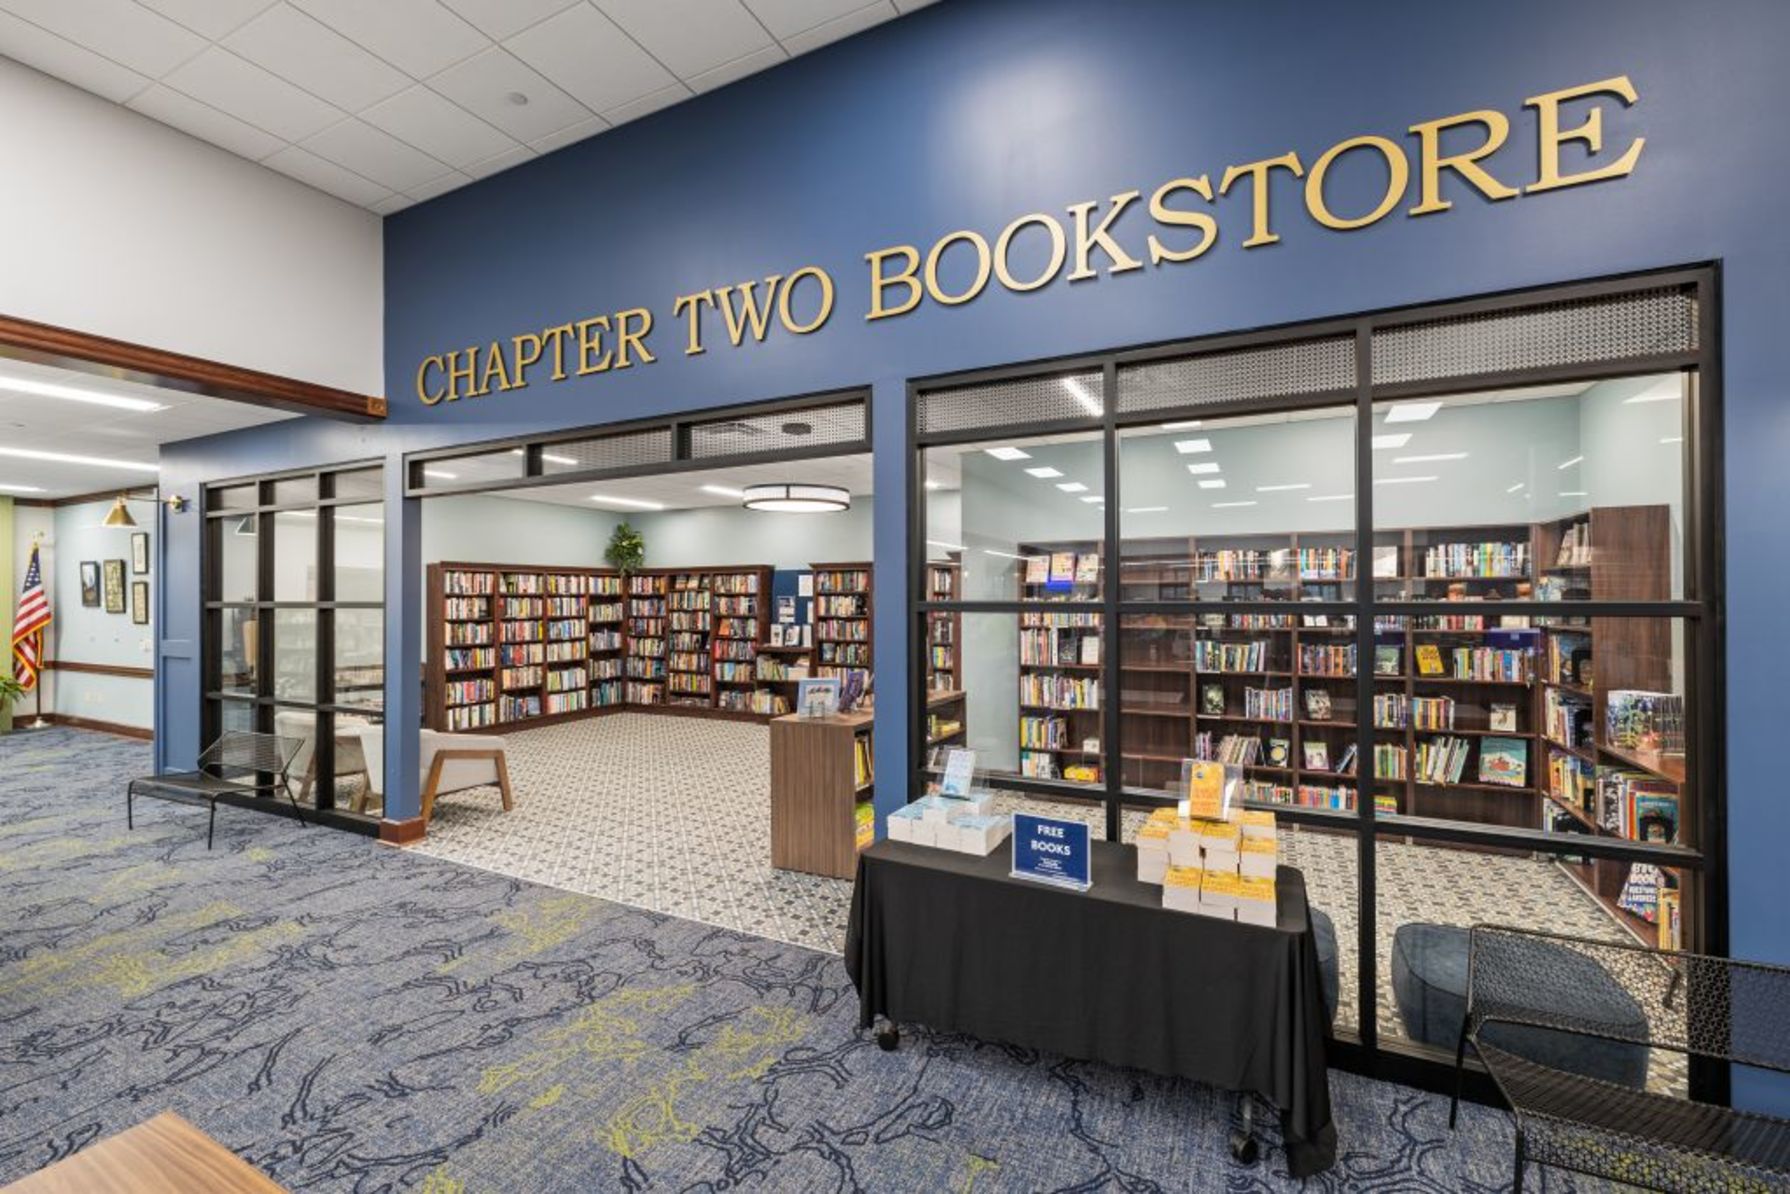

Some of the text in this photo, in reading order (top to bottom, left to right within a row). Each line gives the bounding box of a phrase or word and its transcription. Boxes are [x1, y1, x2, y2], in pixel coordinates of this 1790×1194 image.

[416, 74, 1647, 406] CHAPTER TWO BOOKSTORE
[1037, 824, 1064, 839] FREE
[1030, 839, 1072, 857] BOOKS
